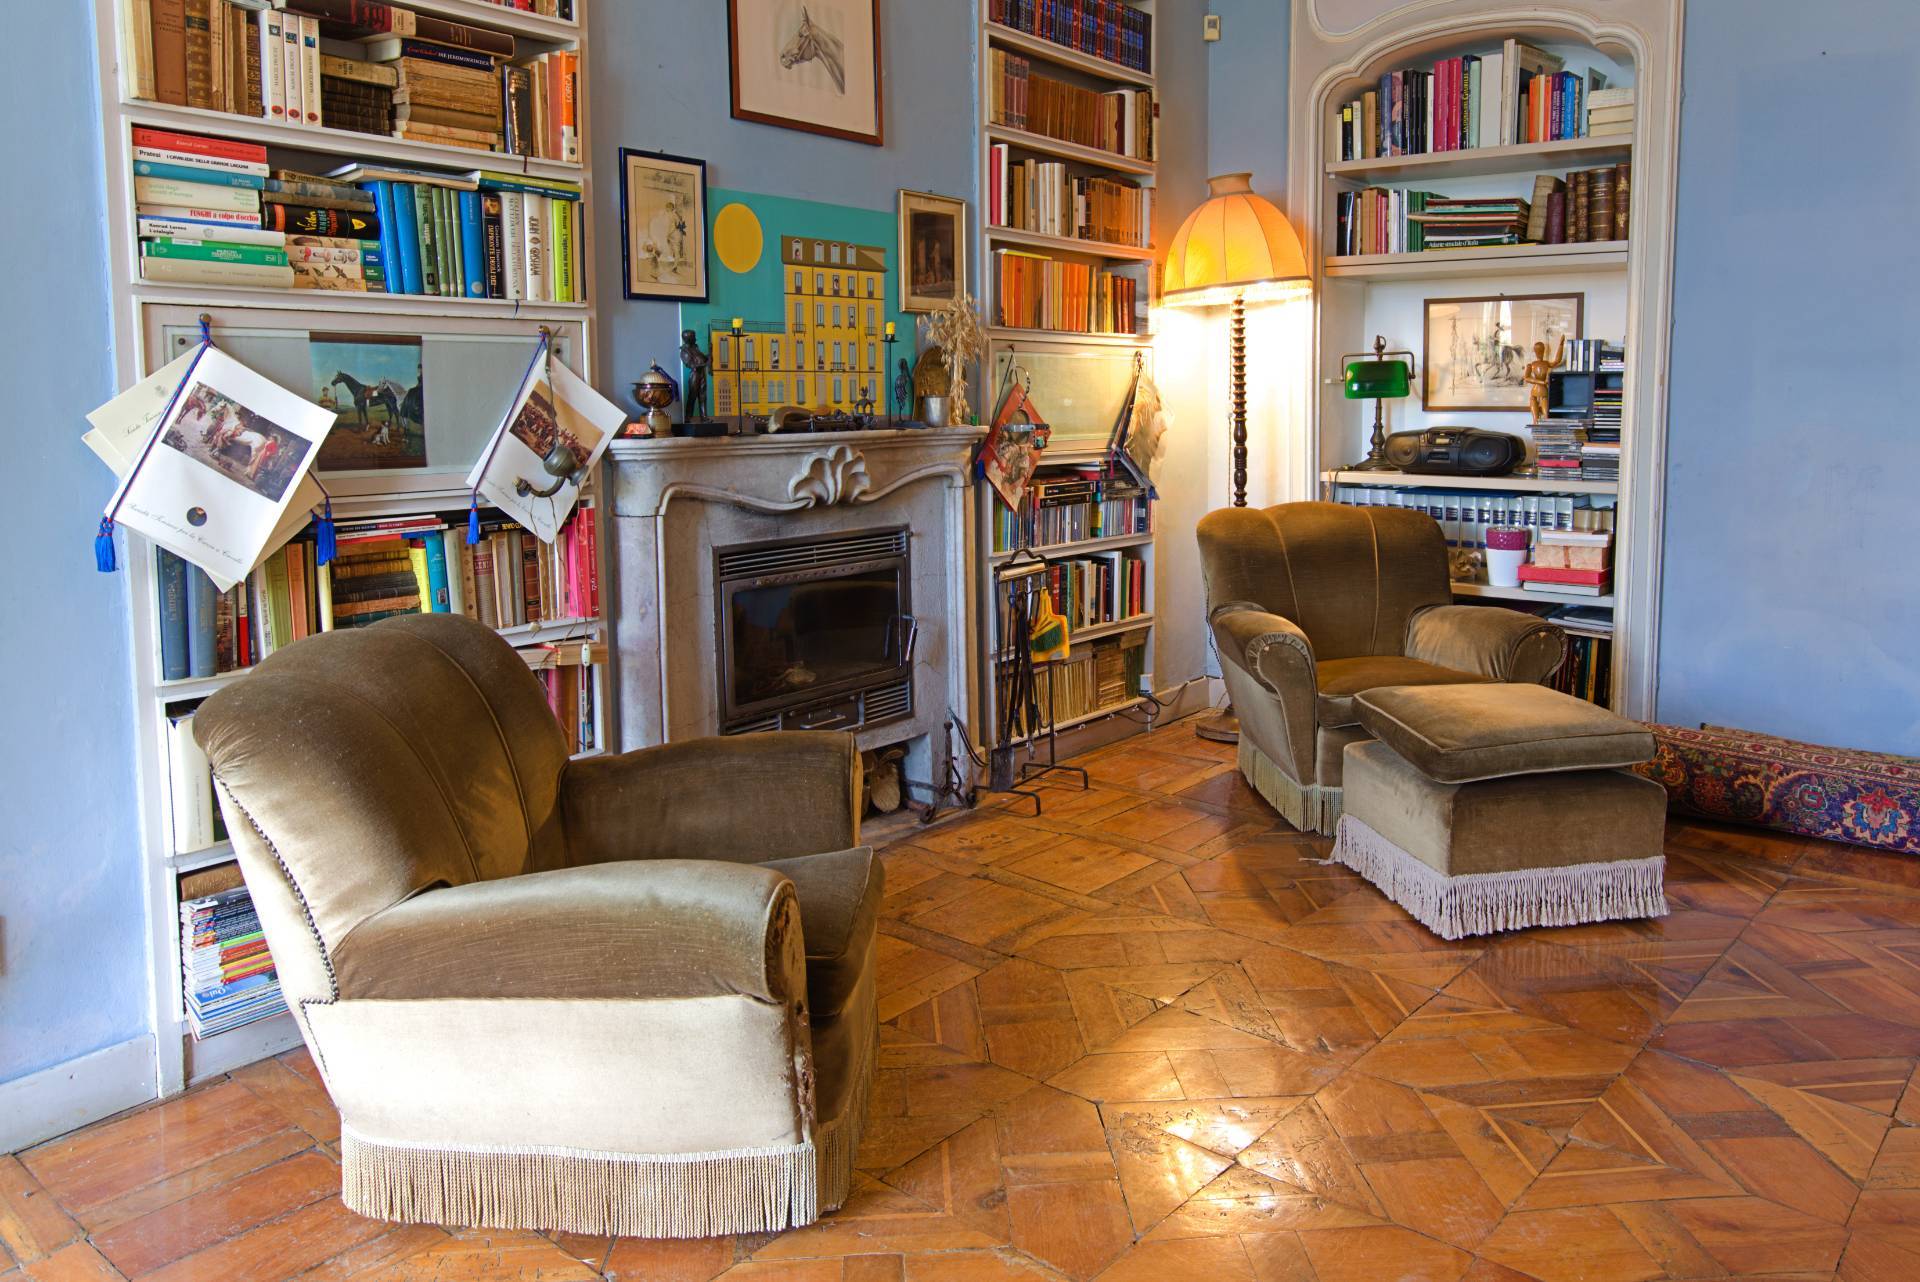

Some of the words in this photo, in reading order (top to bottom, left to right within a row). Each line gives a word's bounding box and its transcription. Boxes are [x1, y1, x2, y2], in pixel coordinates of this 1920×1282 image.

[565, 74, 573, 103] LORCA
[139, 149, 161, 158] Pratesi
[190, 209, 212, 218] FUNGHI
[218, 212, 235, 220] colpo
[529, 216, 540, 234] JOHN
[530, 247, 542, 276] GRISHAM
